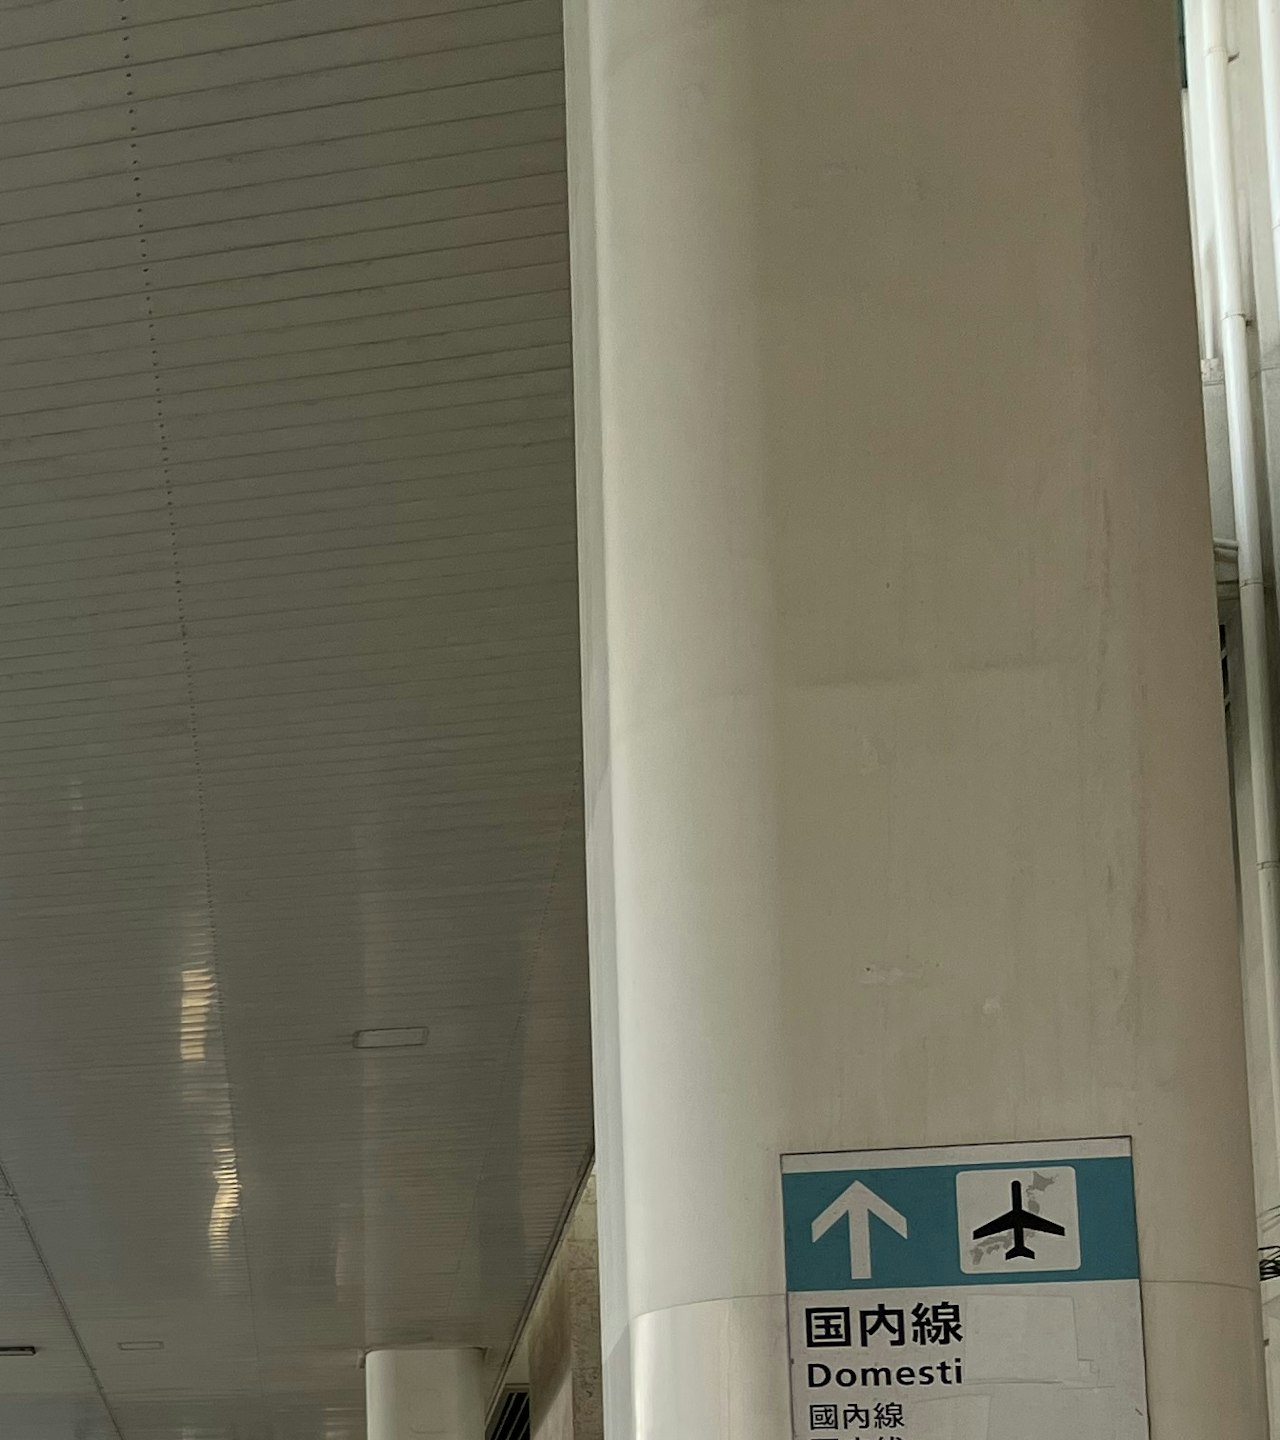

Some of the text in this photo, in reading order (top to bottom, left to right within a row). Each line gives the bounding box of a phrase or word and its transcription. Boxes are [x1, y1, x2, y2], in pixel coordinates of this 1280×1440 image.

[804, 1301, 964, 1348] 国内線
[807, 1357, 963, 1388] Domesti
